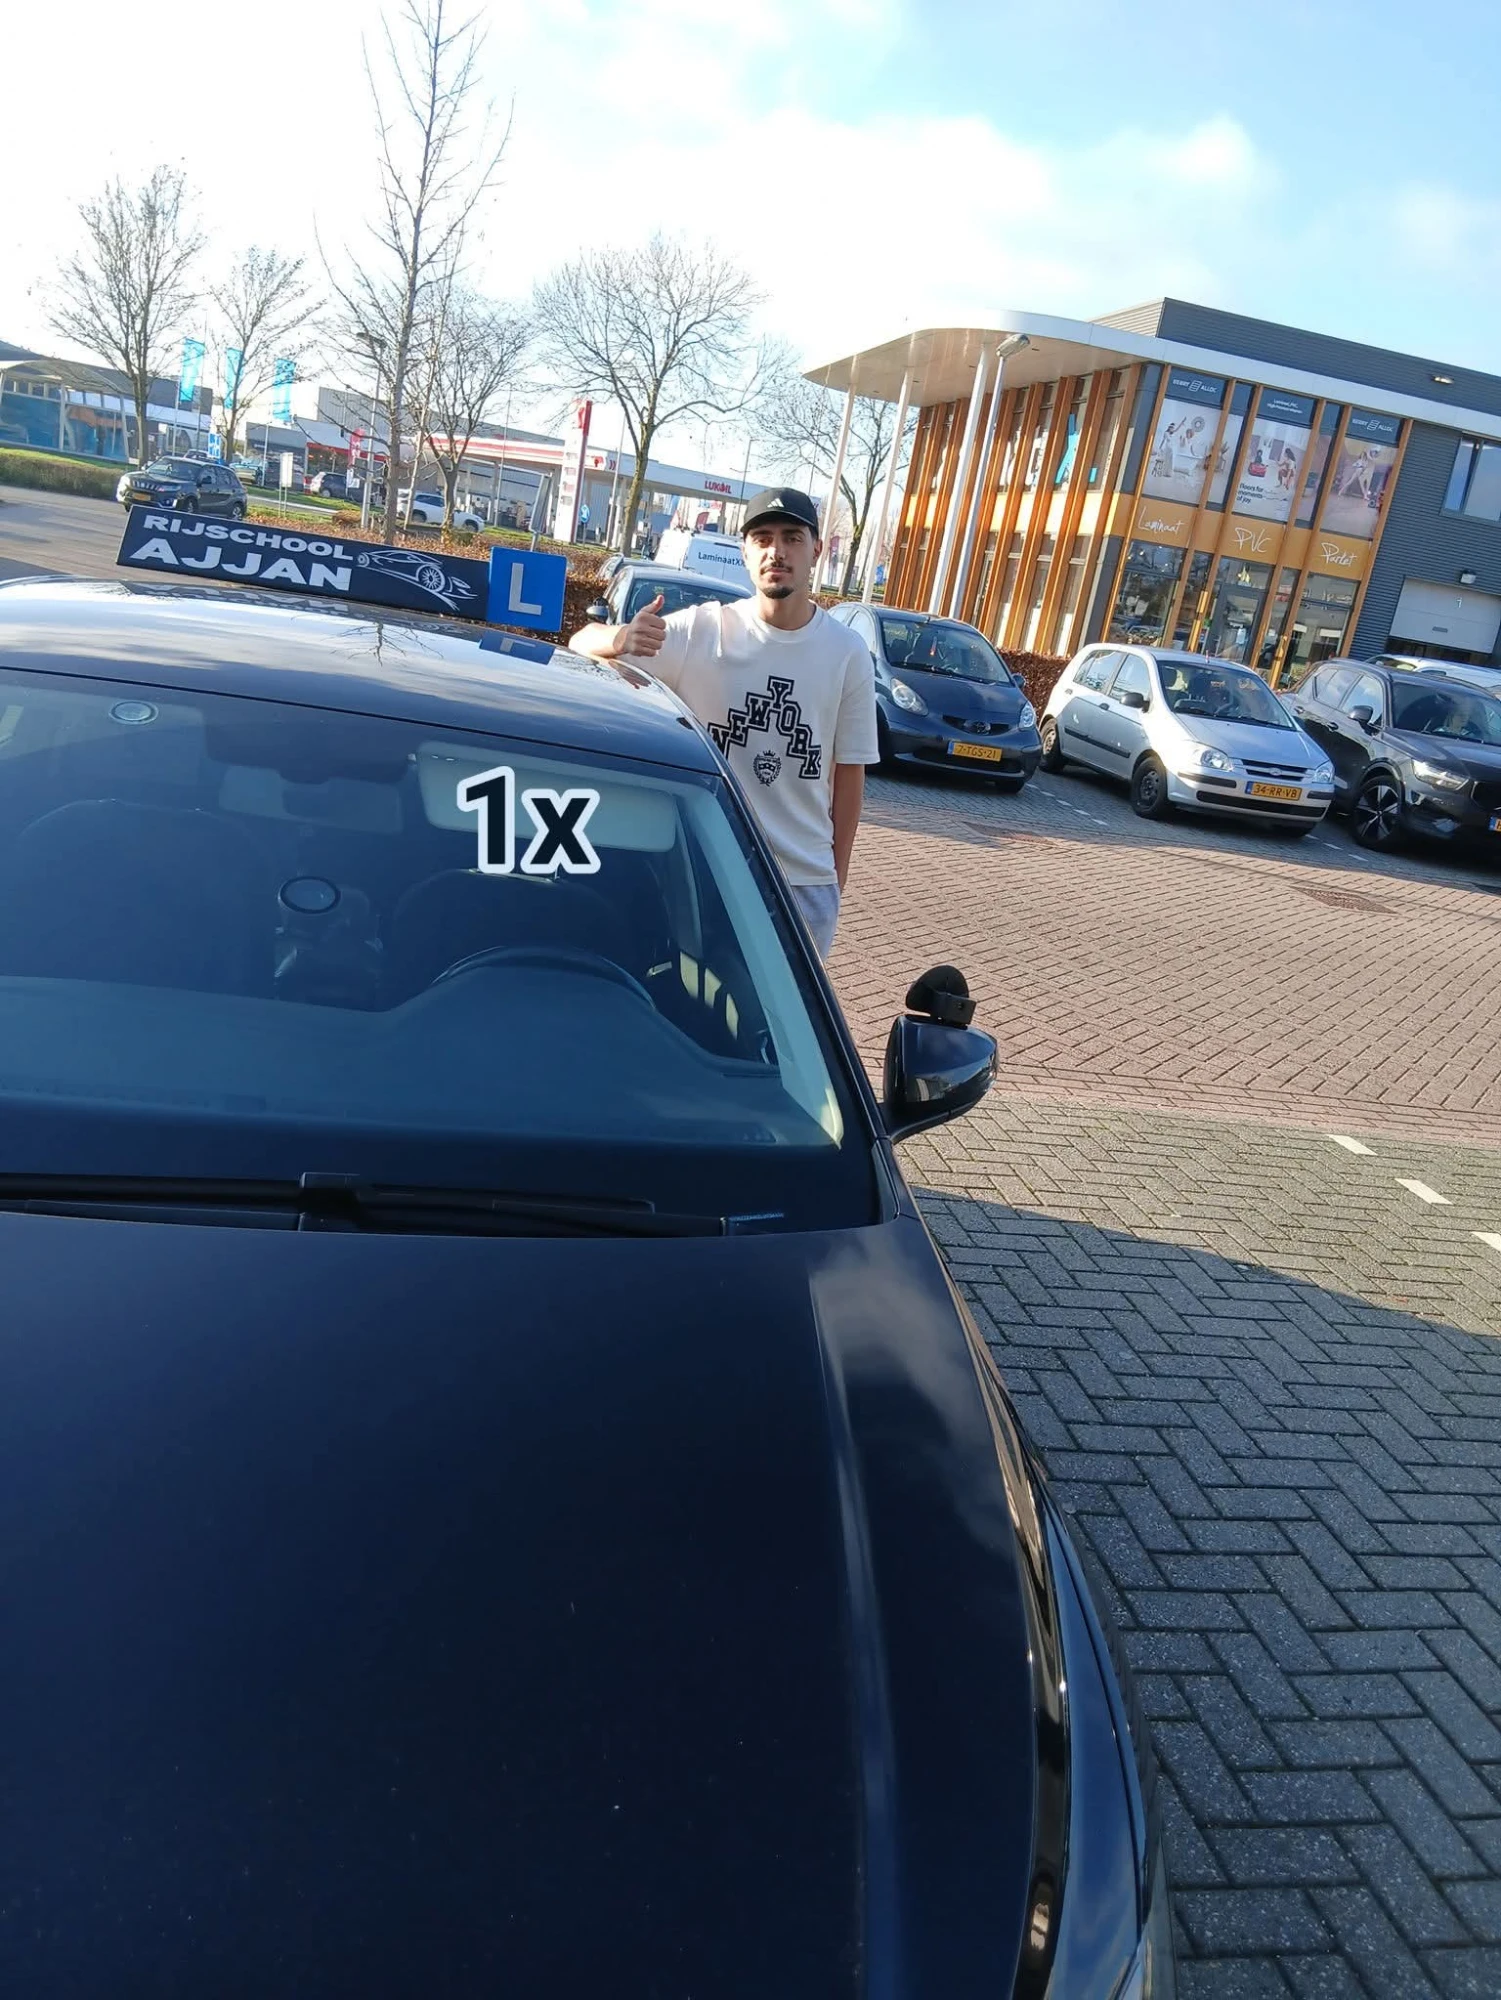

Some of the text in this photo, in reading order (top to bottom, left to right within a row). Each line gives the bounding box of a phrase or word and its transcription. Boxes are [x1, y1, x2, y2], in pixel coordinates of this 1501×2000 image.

[704, 480, 732, 494] LUKOIL
[143, 515, 354, 561] RIJSCHOOL
[1138, 506, 1185, 535] Laminaat
[1232, 527, 1273, 553] PVC
[130, 538, 353, 591] AJJAN
[508, 562, 542, 616] L
[767, 675, 822, 780] YORK
